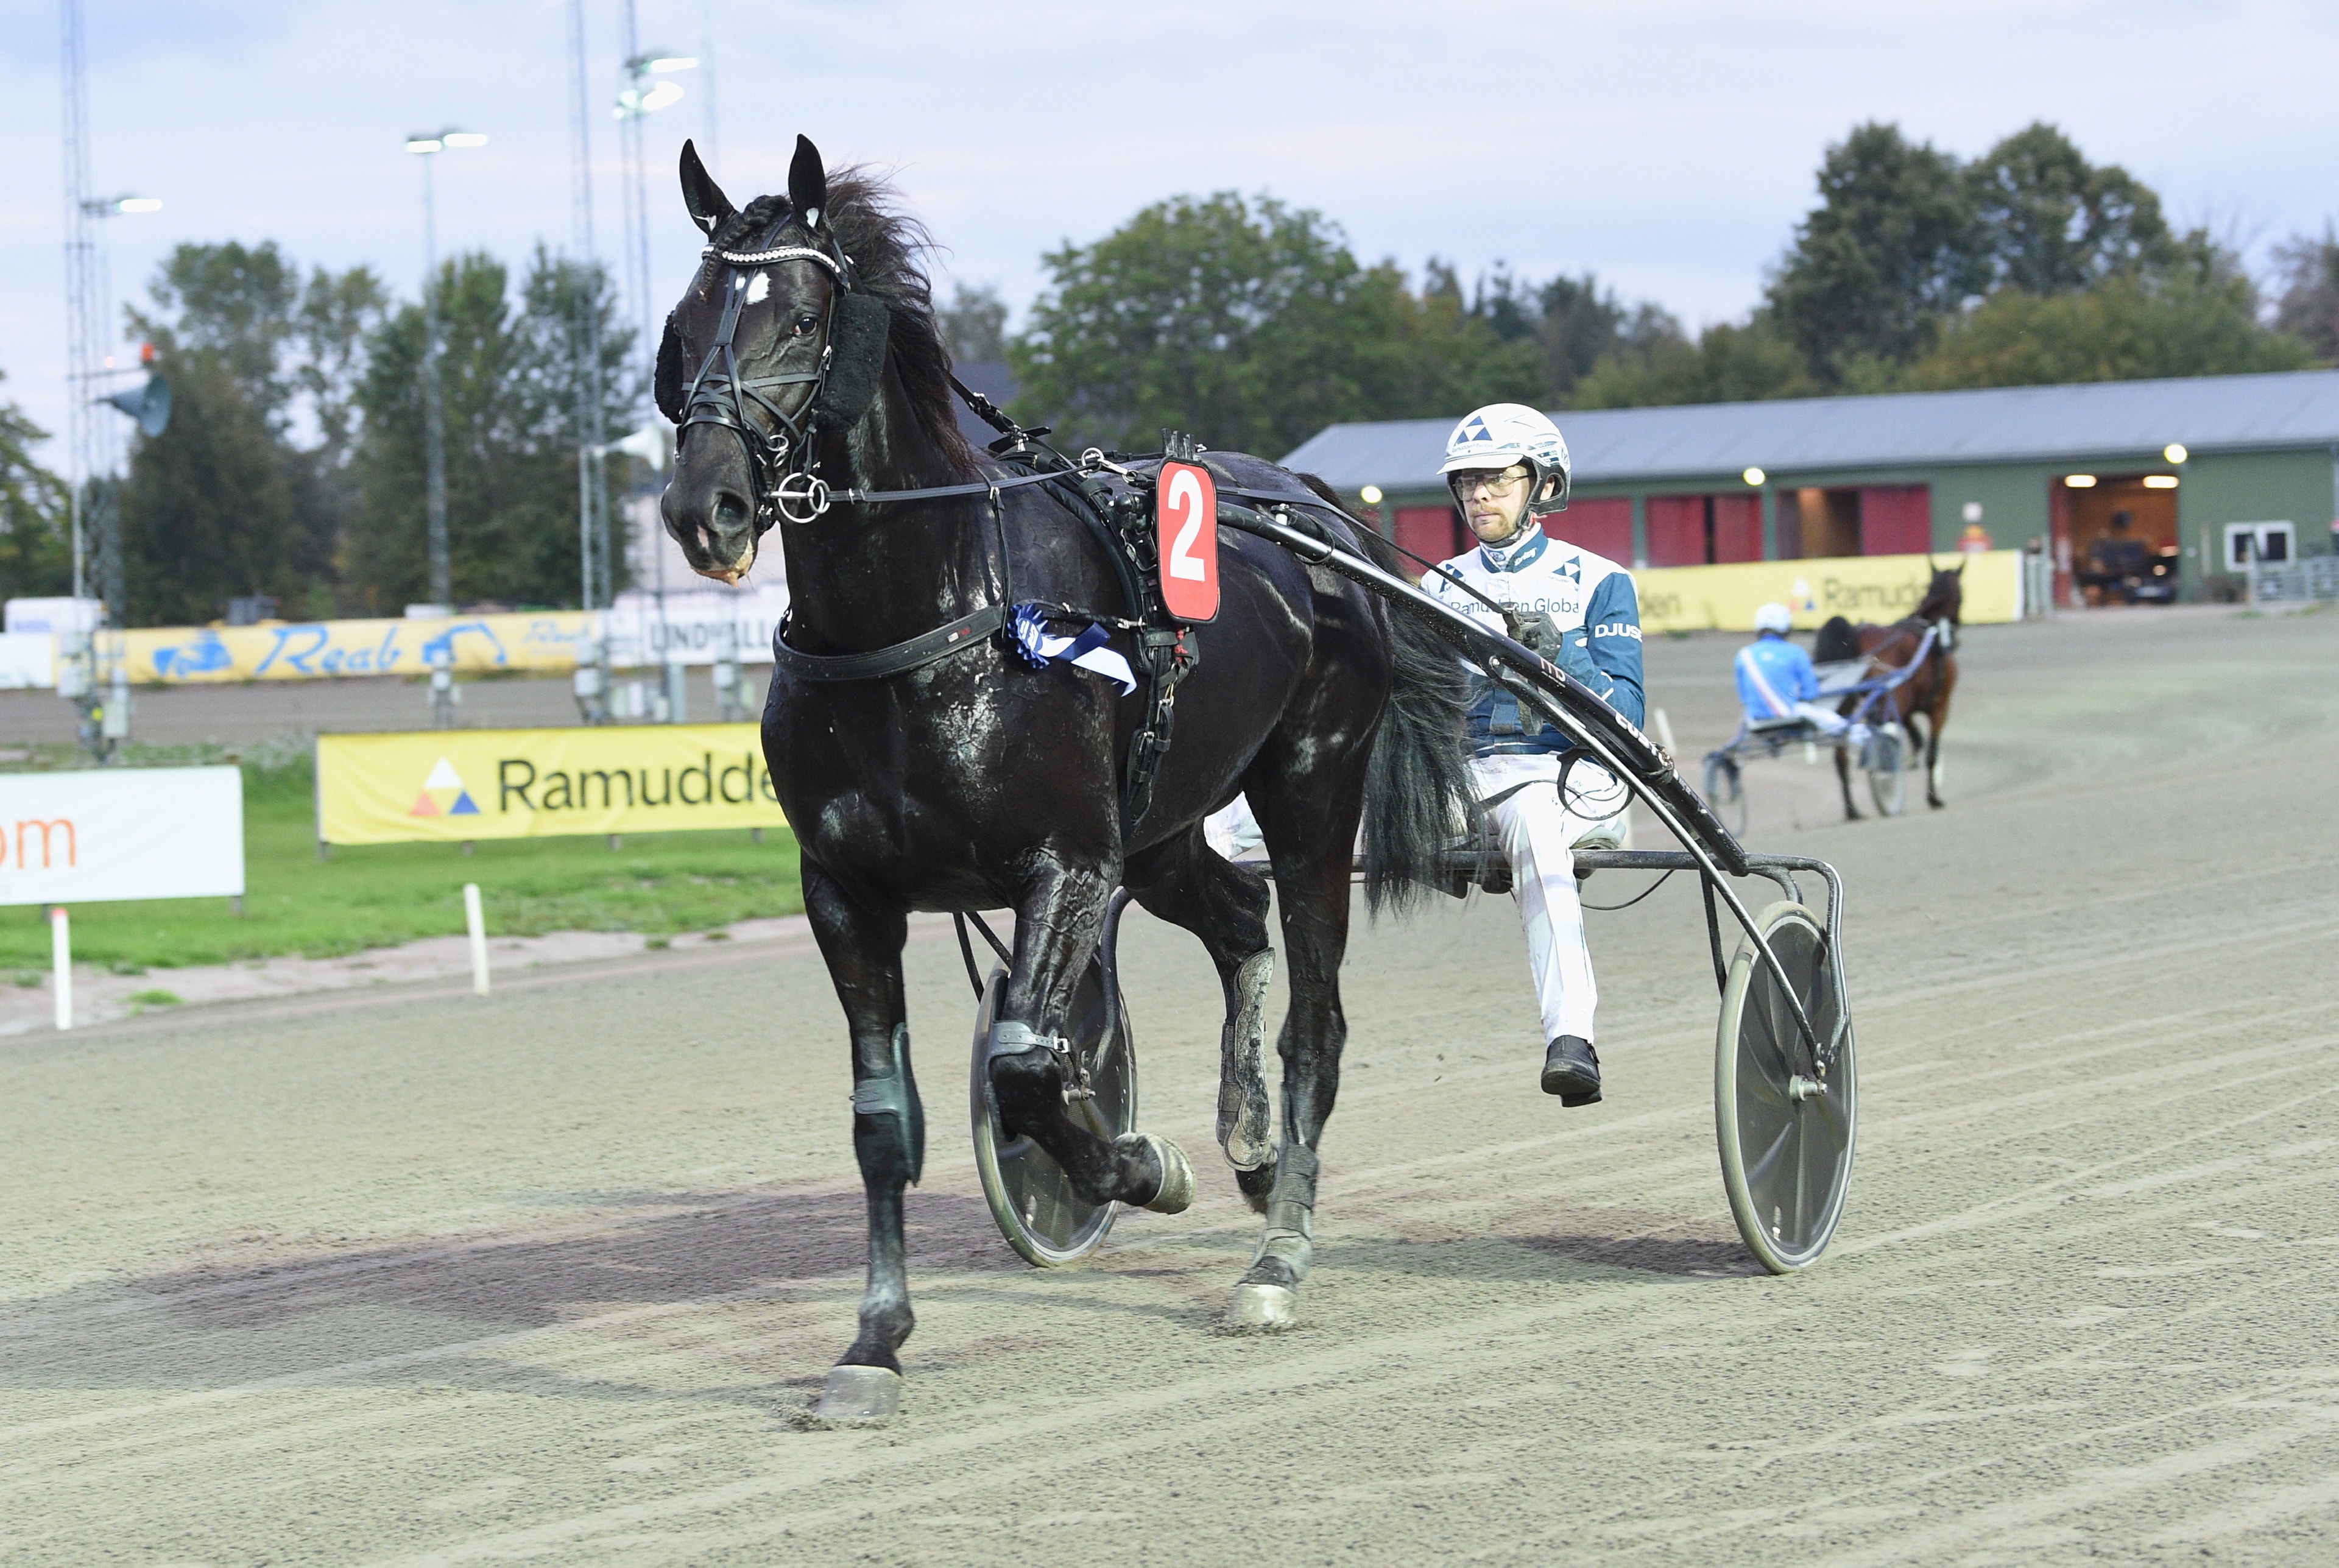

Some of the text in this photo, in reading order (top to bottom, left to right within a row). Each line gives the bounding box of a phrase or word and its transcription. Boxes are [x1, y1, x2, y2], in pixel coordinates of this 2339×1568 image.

[1168, 470, 1205, 581] 2
[1450, 598, 1529, 615] Ramuen
[1824, 576, 1930, 610] Ramud
[0, 819, 76, 870] m
